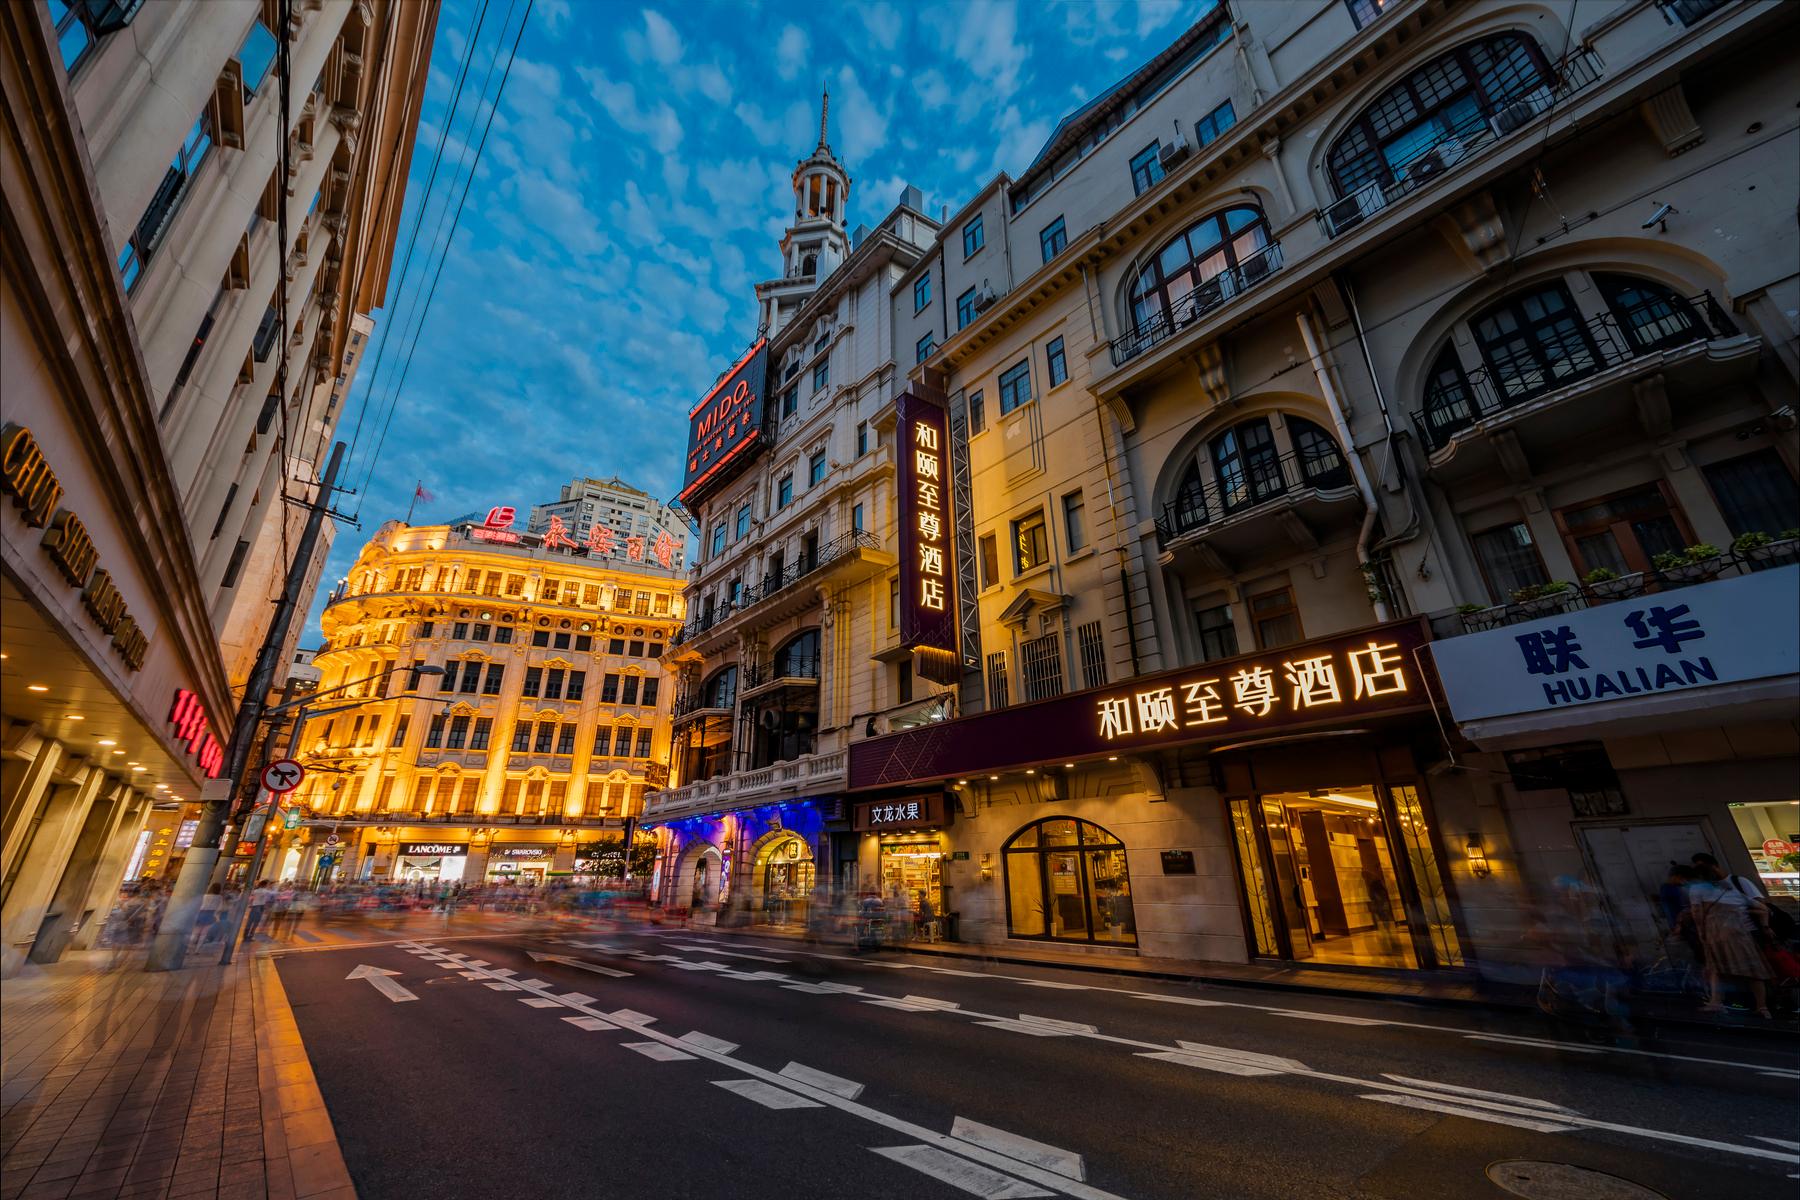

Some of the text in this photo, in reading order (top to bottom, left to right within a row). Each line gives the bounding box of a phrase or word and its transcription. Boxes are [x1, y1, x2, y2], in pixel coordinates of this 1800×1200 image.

[697, 380, 748, 441] MIDO
[1, 424, 64, 531] CHUN
[48, 509, 100, 588] SHEN
[915, 421, 944, 612] 和颐至尊酒店
[1514, 603, 1706, 675] 联华
[1097, 642, 1407, 740] 和颐至尊酒店
[1542, 656, 1719, 705] HUALIAN
[871, 802, 919, 824] 文龙水果
[408, 844, 452, 854] LANCÔME
